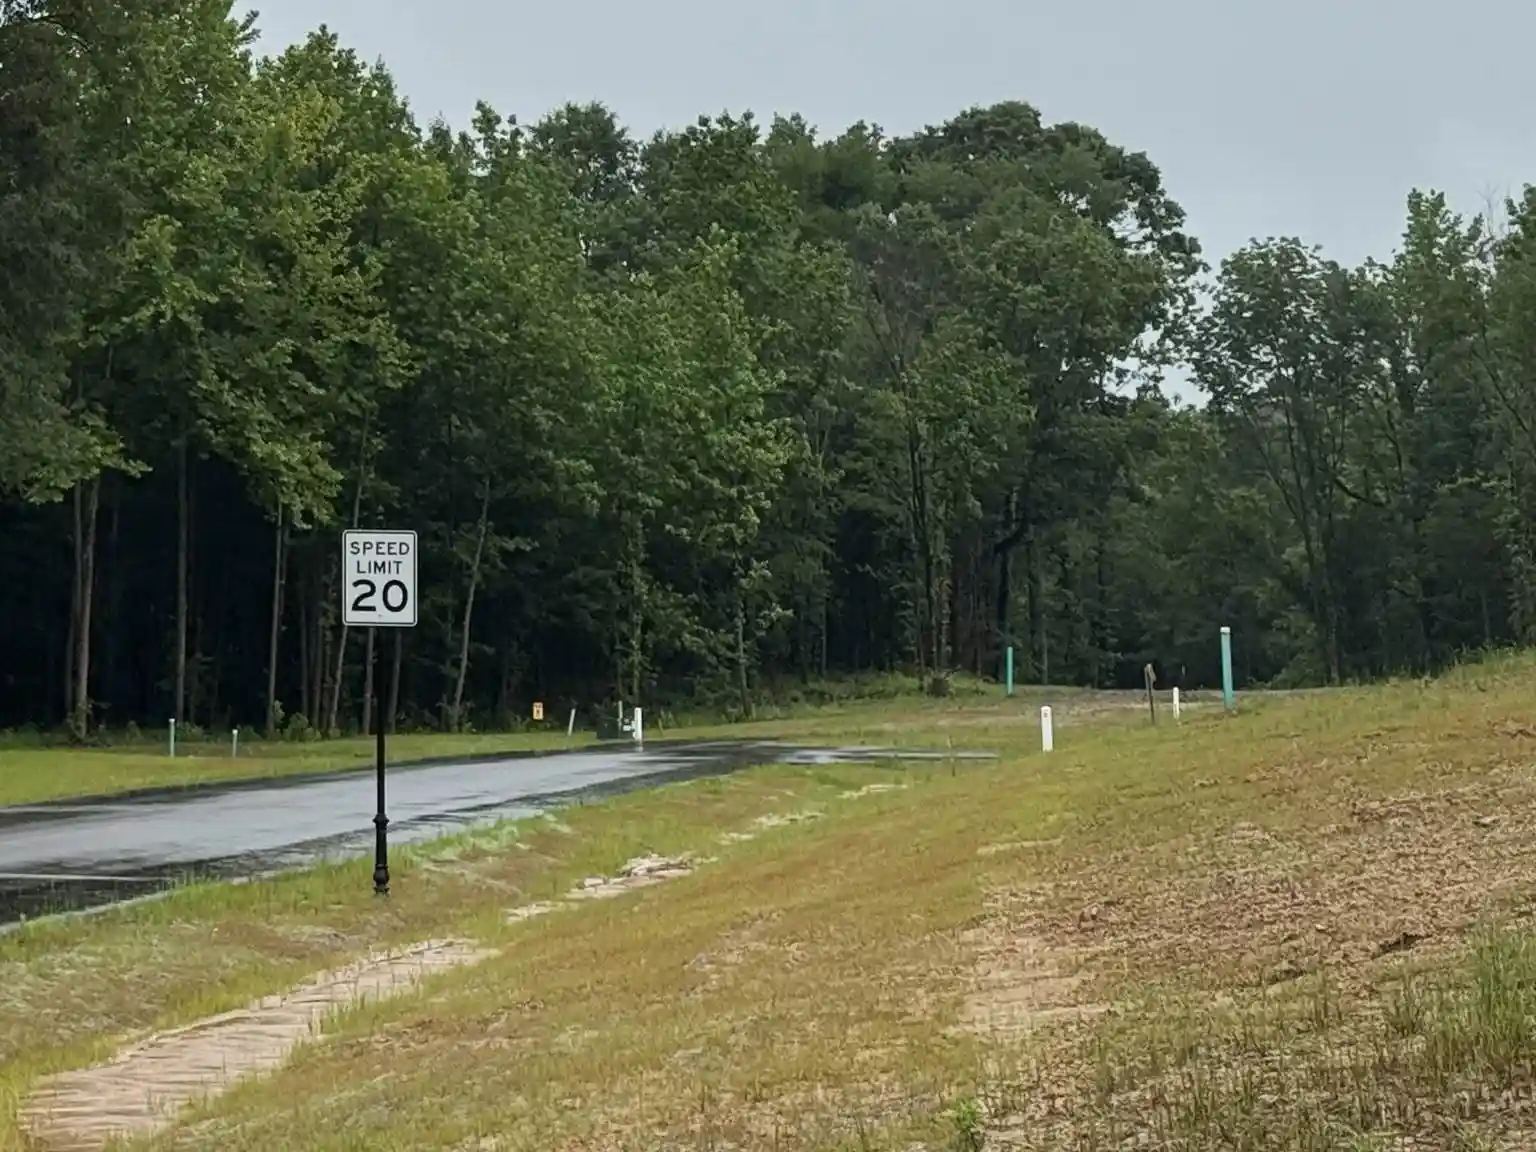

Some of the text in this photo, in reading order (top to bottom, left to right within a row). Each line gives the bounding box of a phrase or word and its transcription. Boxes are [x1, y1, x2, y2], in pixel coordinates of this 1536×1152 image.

[350, 541, 410, 555] SPEED
[357, 560, 402, 574] LIMIT
[351, 579, 408, 612] 20
